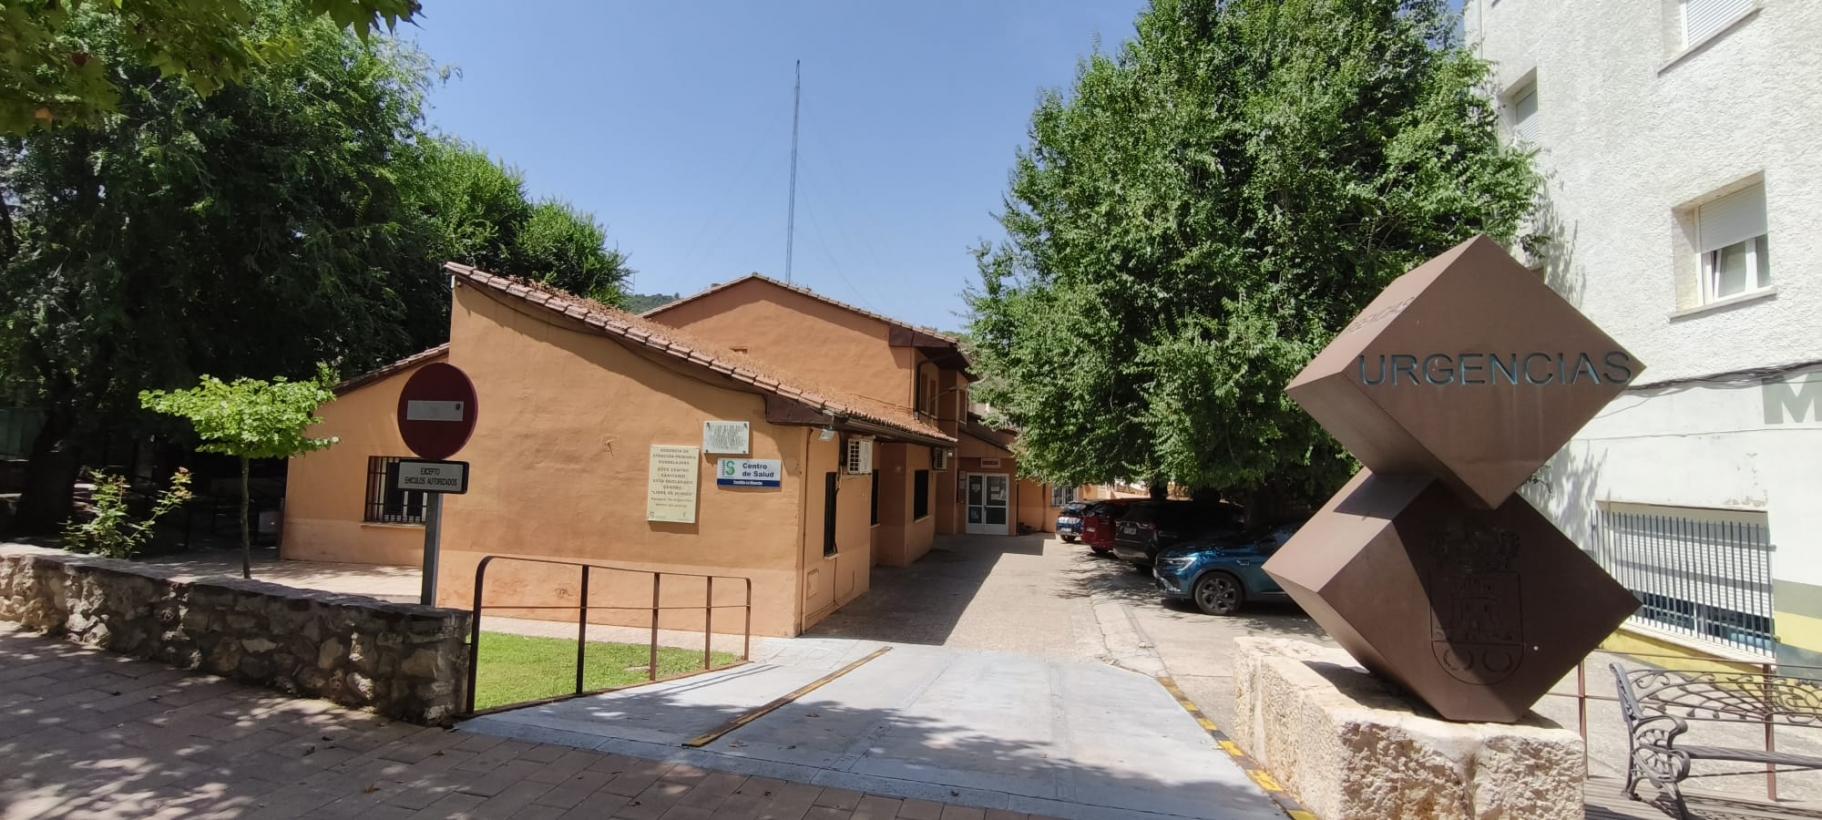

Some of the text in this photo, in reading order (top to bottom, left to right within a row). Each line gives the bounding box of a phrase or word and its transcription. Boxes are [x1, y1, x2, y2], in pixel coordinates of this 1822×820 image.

[1359, 351, 1632, 386] URGENCIAS
[742, 462, 768, 470] Centro
[753, 470, 775, 478] Salud
